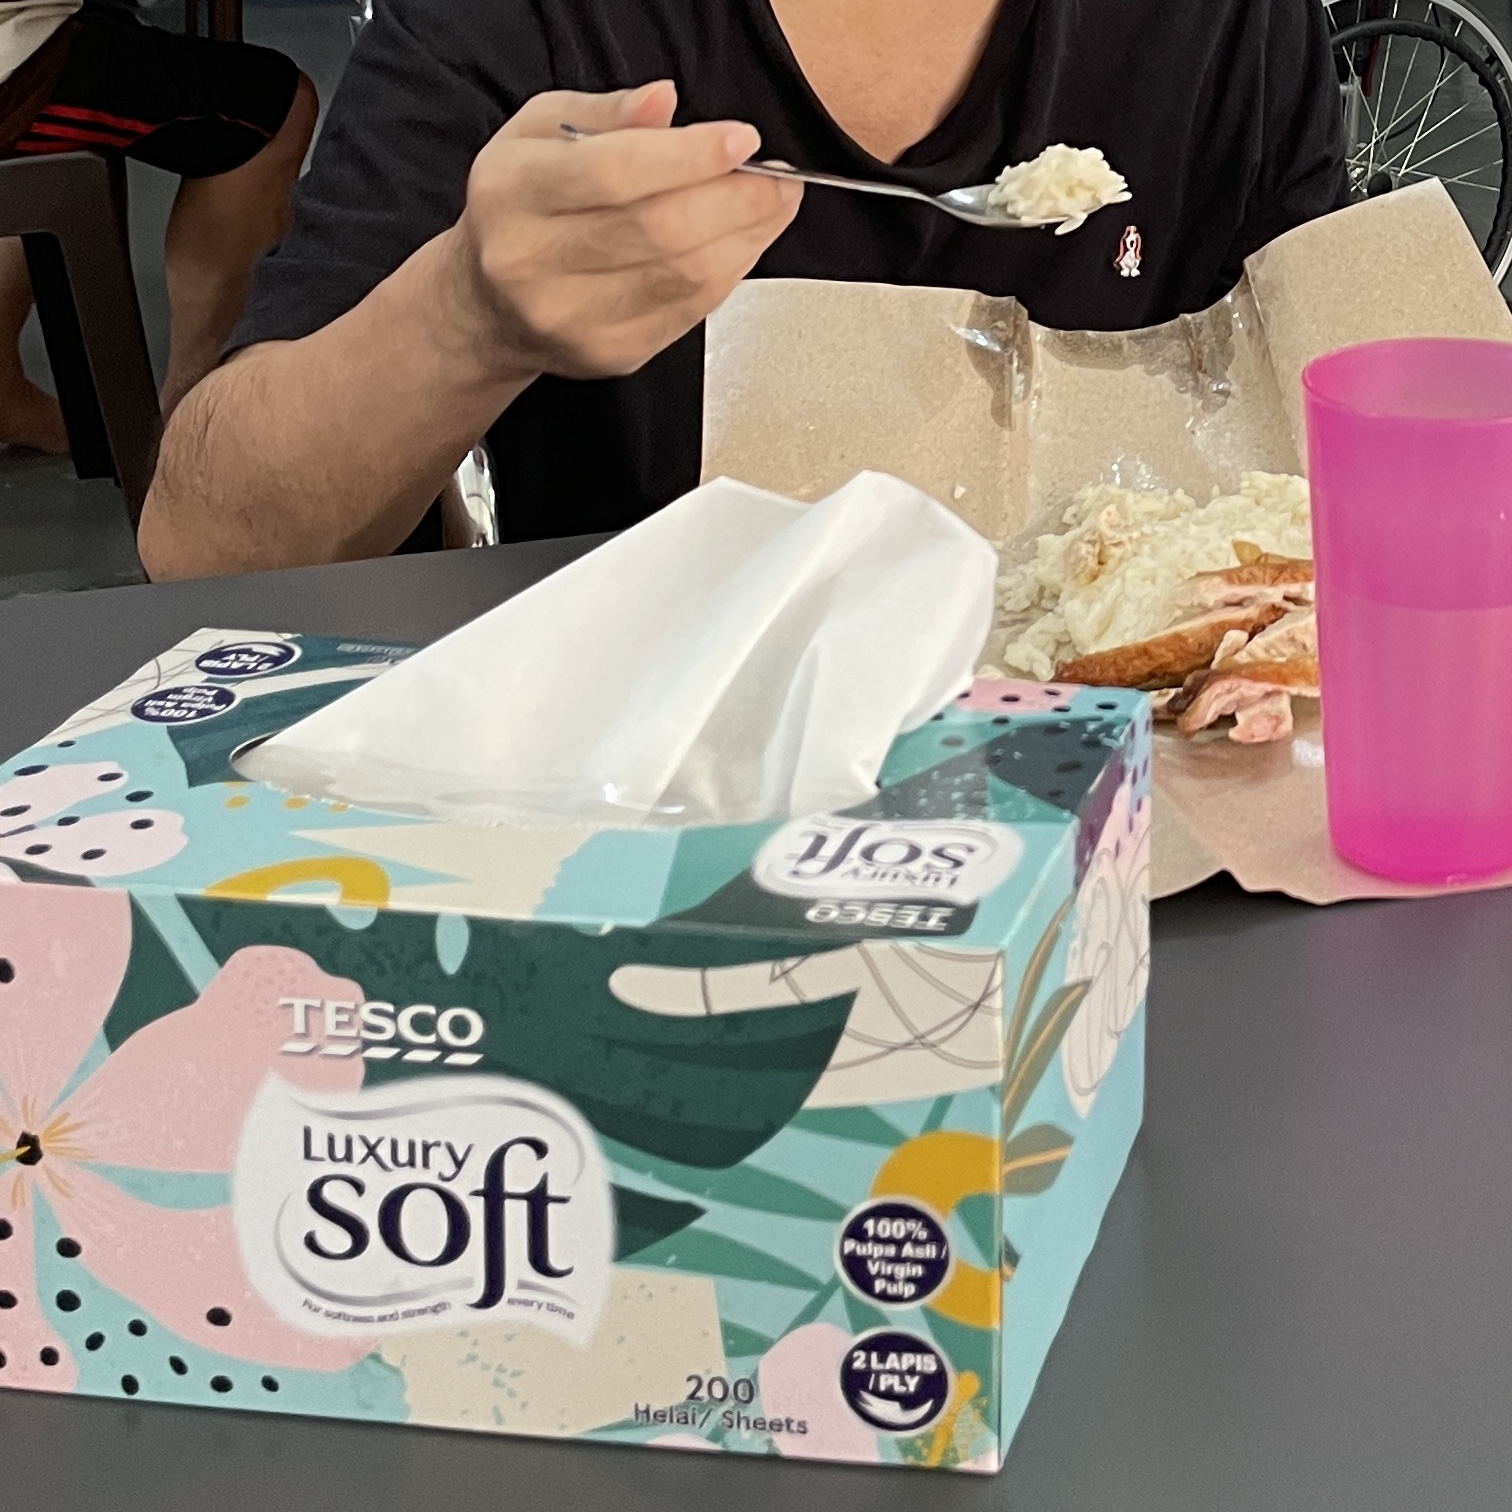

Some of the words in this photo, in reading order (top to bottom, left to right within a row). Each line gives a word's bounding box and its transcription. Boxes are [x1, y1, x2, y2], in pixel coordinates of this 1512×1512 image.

[787, 822, 977, 879] soft
[805, 903, 950, 931] TESCO
[278, 996, 486, 1048] TESCO
[303, 1125, 475, 1182] Luxury
[304, 1135, 575, 1310] soft
[863, 1218, 928, 1240] 100%
[843, 1238, 896, 1258] Pulpa
[866, 1259, 923, 1279] Virgin
[874, 1277, 915, 1298] Pulp
[377, 1310, 399, 1322] and
[507, 1296, 543, 1311] every
[546, 1300, 575, 1320] time
[852, 1349, 867, 1369] 2
[870, 1351, 938, 1374] LAPIS
[685, 1374, 755, 1405] 200
[721, 1409, 809, 1435] Sheets
